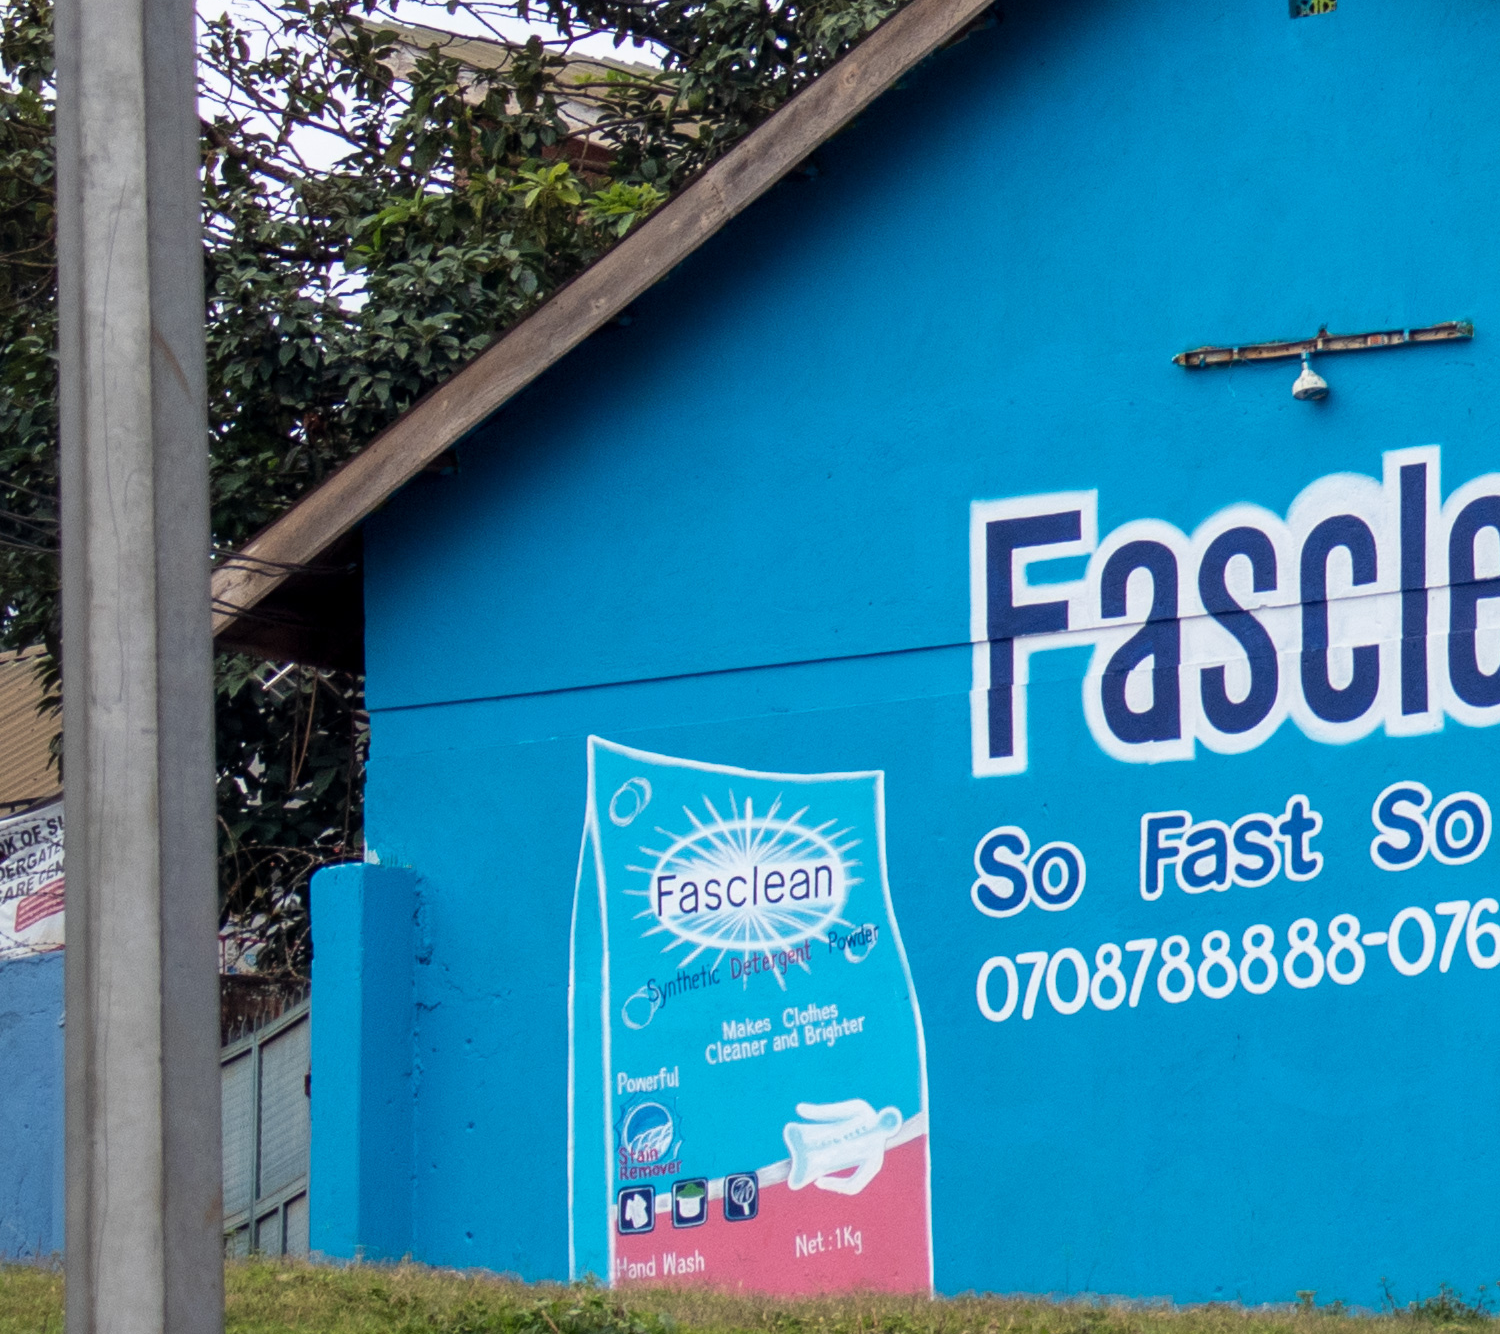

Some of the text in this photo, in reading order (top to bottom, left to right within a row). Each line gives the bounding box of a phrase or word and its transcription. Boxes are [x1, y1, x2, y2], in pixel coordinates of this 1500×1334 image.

[971, 826, 1086, 918] So
[1140, 794, 1323, 901] Fast
[1370, 781, 1492, 871] So
[657, 864, 833, 917] Fasclean
[647, 924, 880, 1008] Synthetic Detergent Powder
[705, 1016, 866, 1065] Cleaner and Brighter
[722, 1003, 839, 1041] Makes Clothes
[617, 1066, 679, 1095] Powerful
[619, 1145, 659, 1167] Stain
[619, 1158, 683, 1181] Remover
[615, 1250, 705, 1279] Hand Wash
